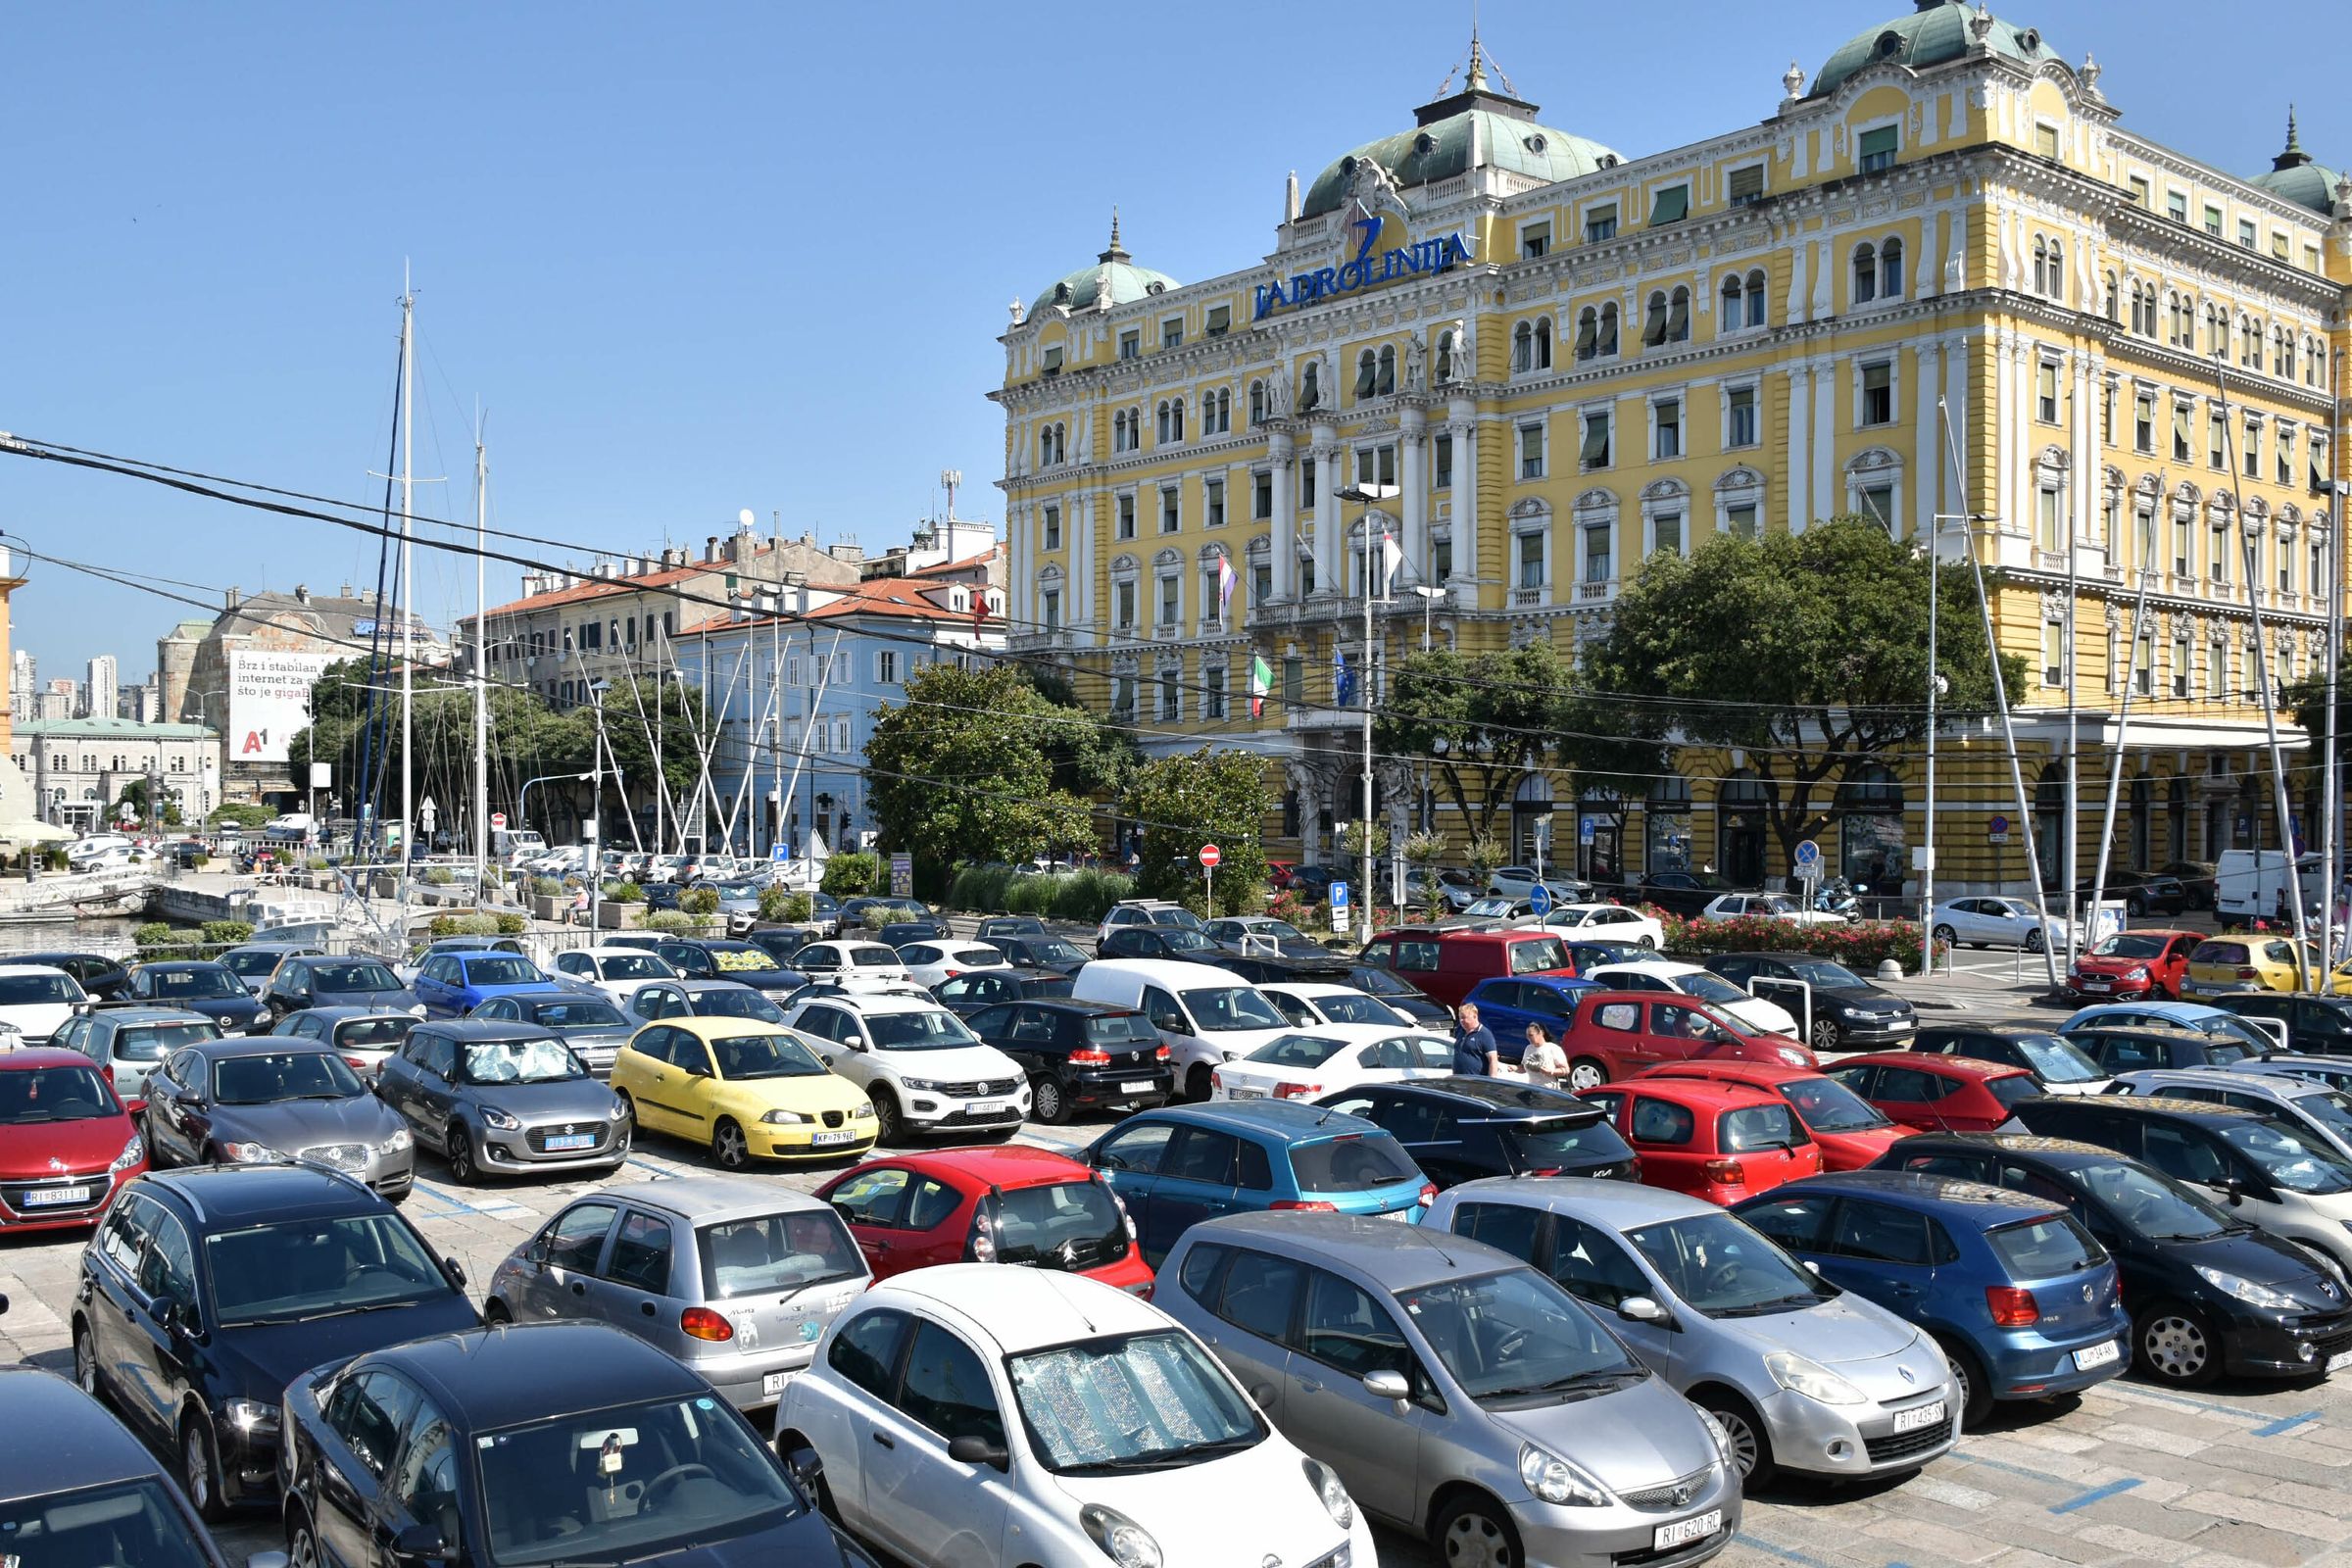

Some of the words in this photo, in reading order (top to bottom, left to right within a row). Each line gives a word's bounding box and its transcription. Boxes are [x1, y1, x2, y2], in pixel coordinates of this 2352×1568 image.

[1254, 231, 1474, 320] JADROLINIJA
[238, 660, 258, 670] Brz
[261, 662, 266, 670] i
[269, 662, 318, 672] stabilan
[237, 672, 287, 684] internet
[290, 676, 303, 685] za
[237, 685, 257, 696] što
[260, 686, 271, 698] je
[242, 728, 268, 754] A1
[777, 847, 785, 858] P
[1335, 886, 1344, 902] P
[818, 1134, 828, 1143] KP
[1592, 1168, 1613, 1178] KIA
[31, 1192, 42, 1201] RI
[772, 1375, 785, 1389] RI
[1900, 1414, 1910, 1429] RI
[1663, 1525, 1676, 1544] RI
[1684, 1512, 1719, 1538] 620-RC
